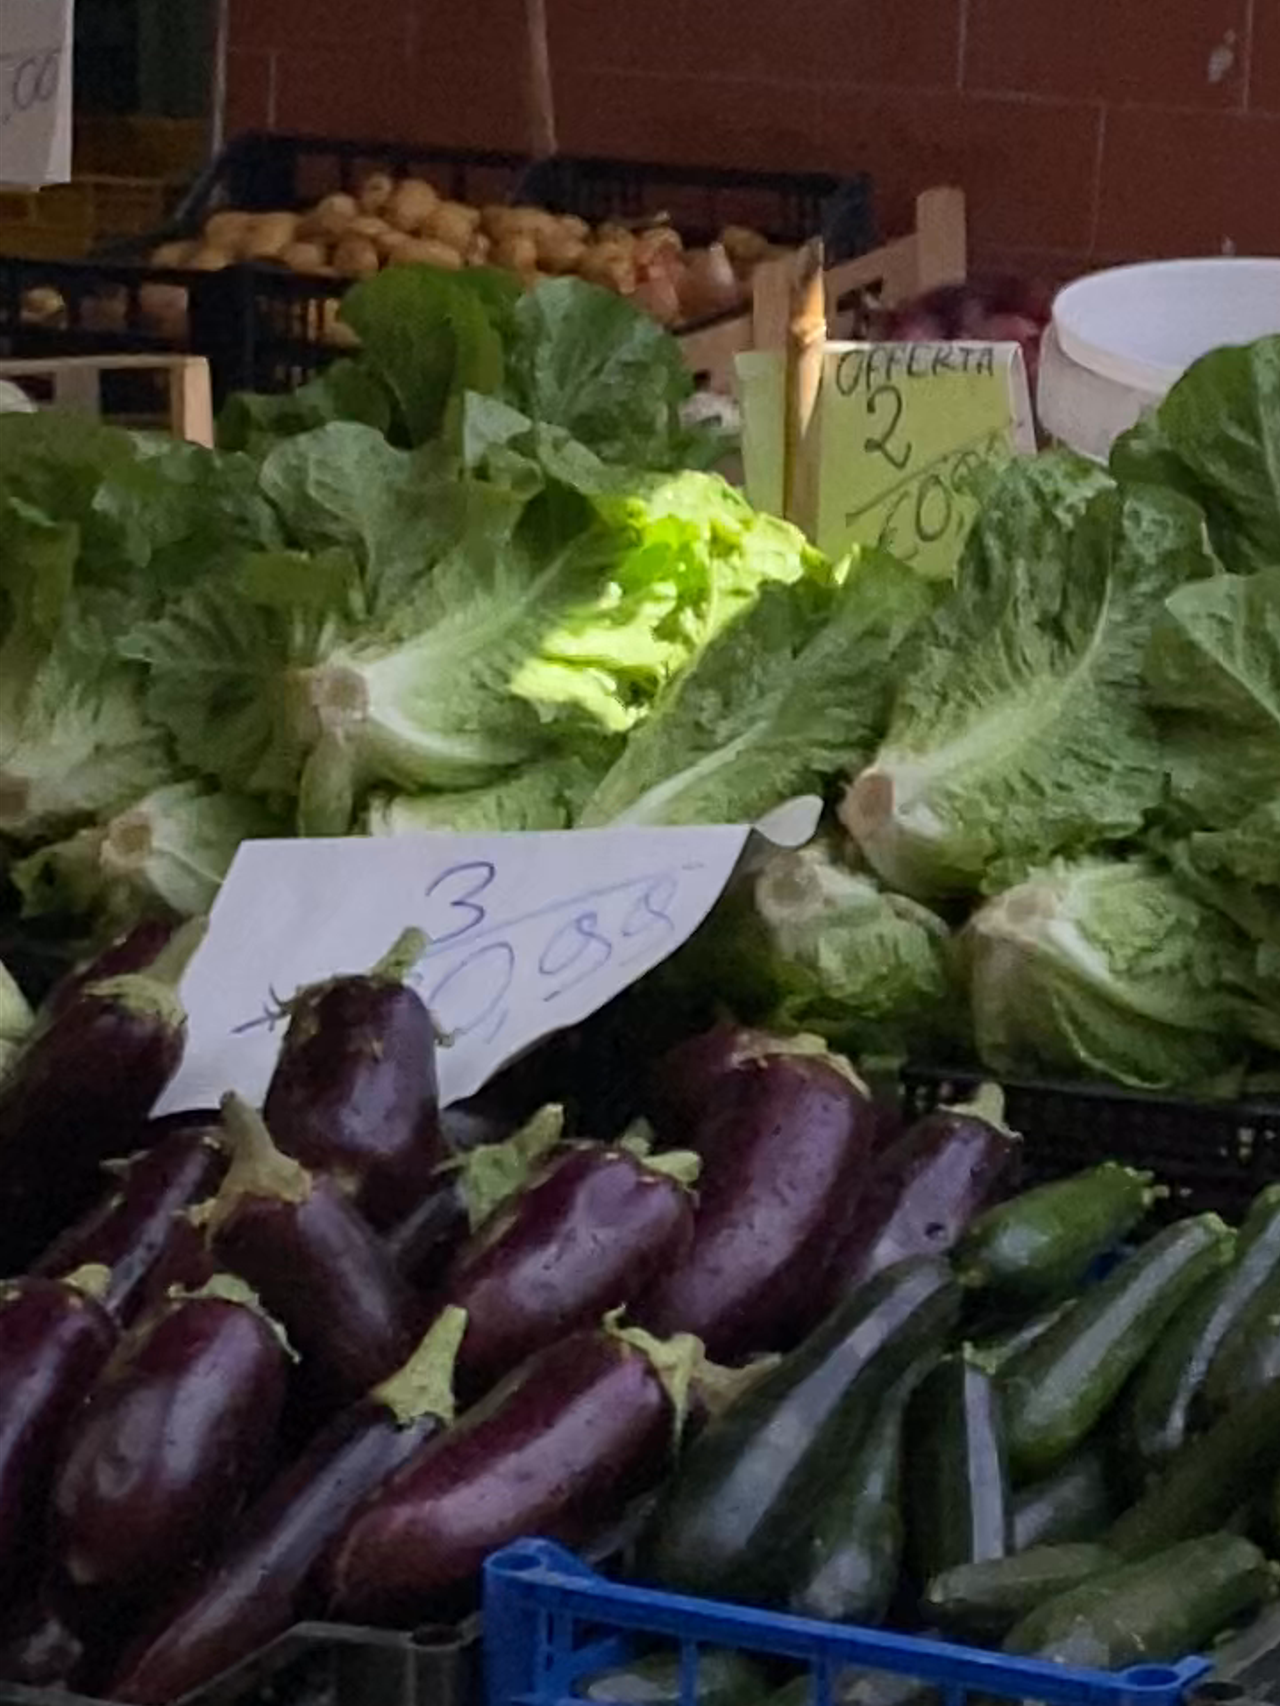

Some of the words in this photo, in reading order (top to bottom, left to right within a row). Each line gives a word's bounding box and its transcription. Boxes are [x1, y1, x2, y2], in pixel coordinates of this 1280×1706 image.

[835, 346, 994, 397] OFFERTA
[863, 385, 913, 470] 2
[424, 860, 497, 945] 3
